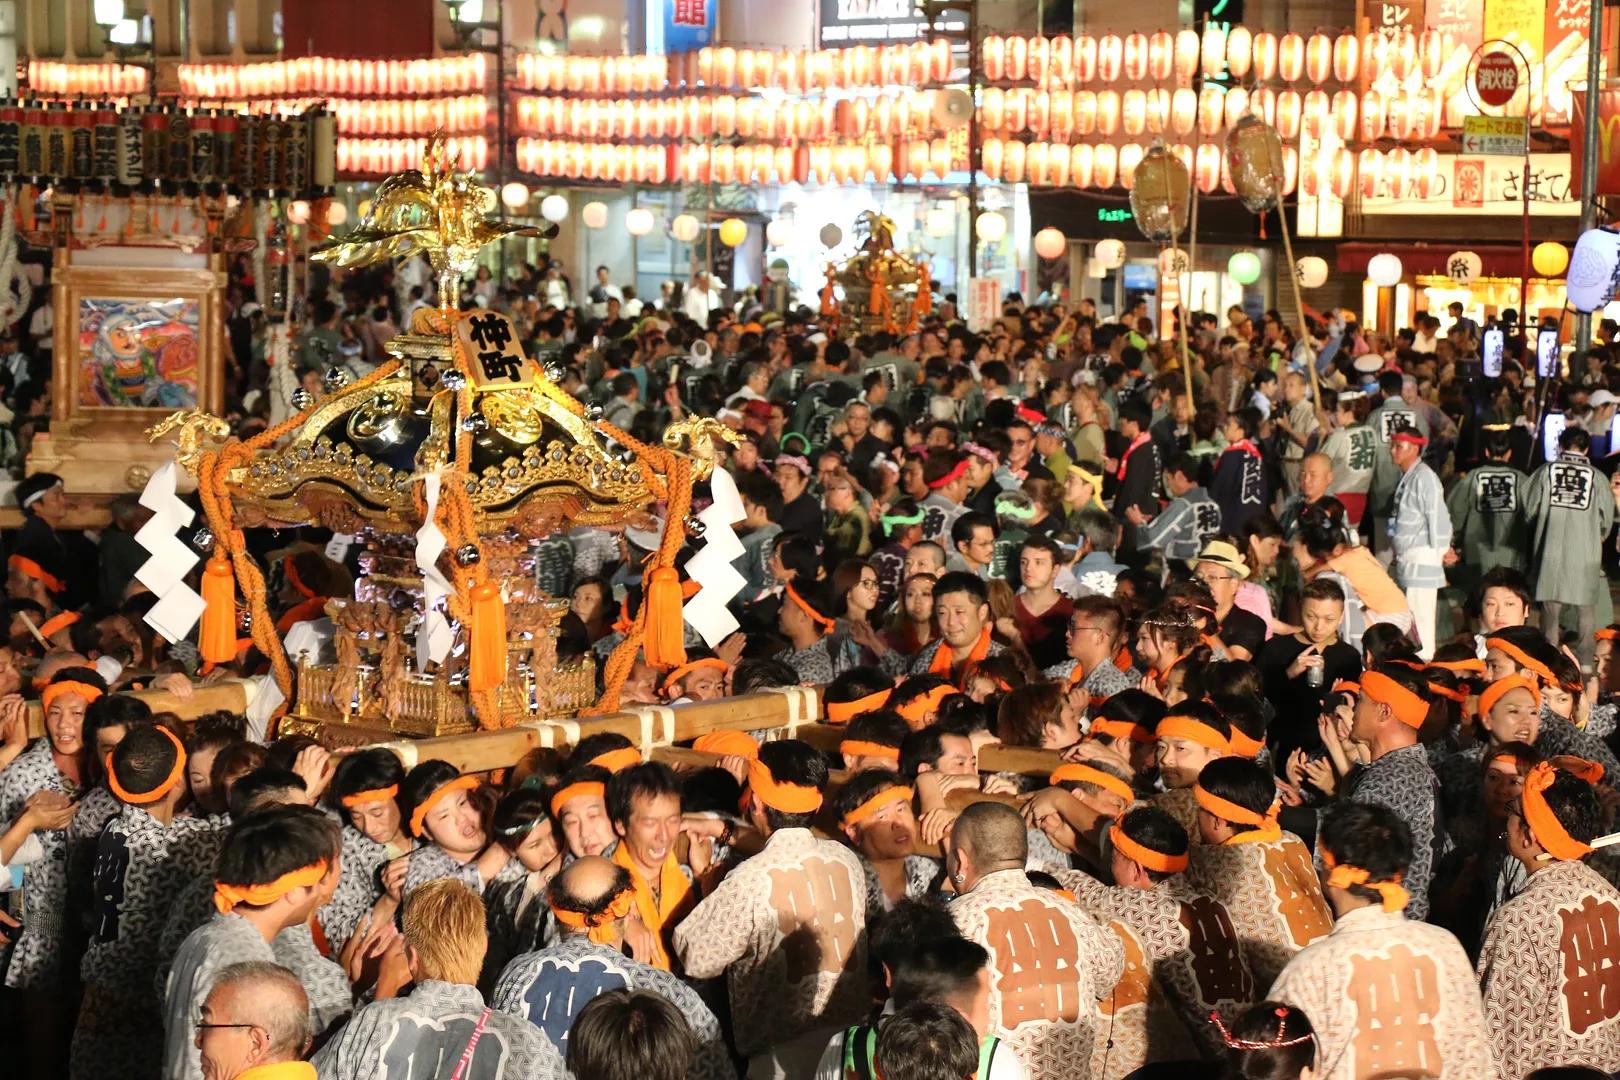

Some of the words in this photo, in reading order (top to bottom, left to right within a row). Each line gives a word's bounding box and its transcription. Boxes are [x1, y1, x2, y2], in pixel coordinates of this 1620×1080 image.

[1382, 3, 1410, 25] ヒレ
[1479, 67, 1516, 90] 消火栓
[1466, 120, 1523, 135] カードでお金
[469, 313, 523, 382] 仲町
